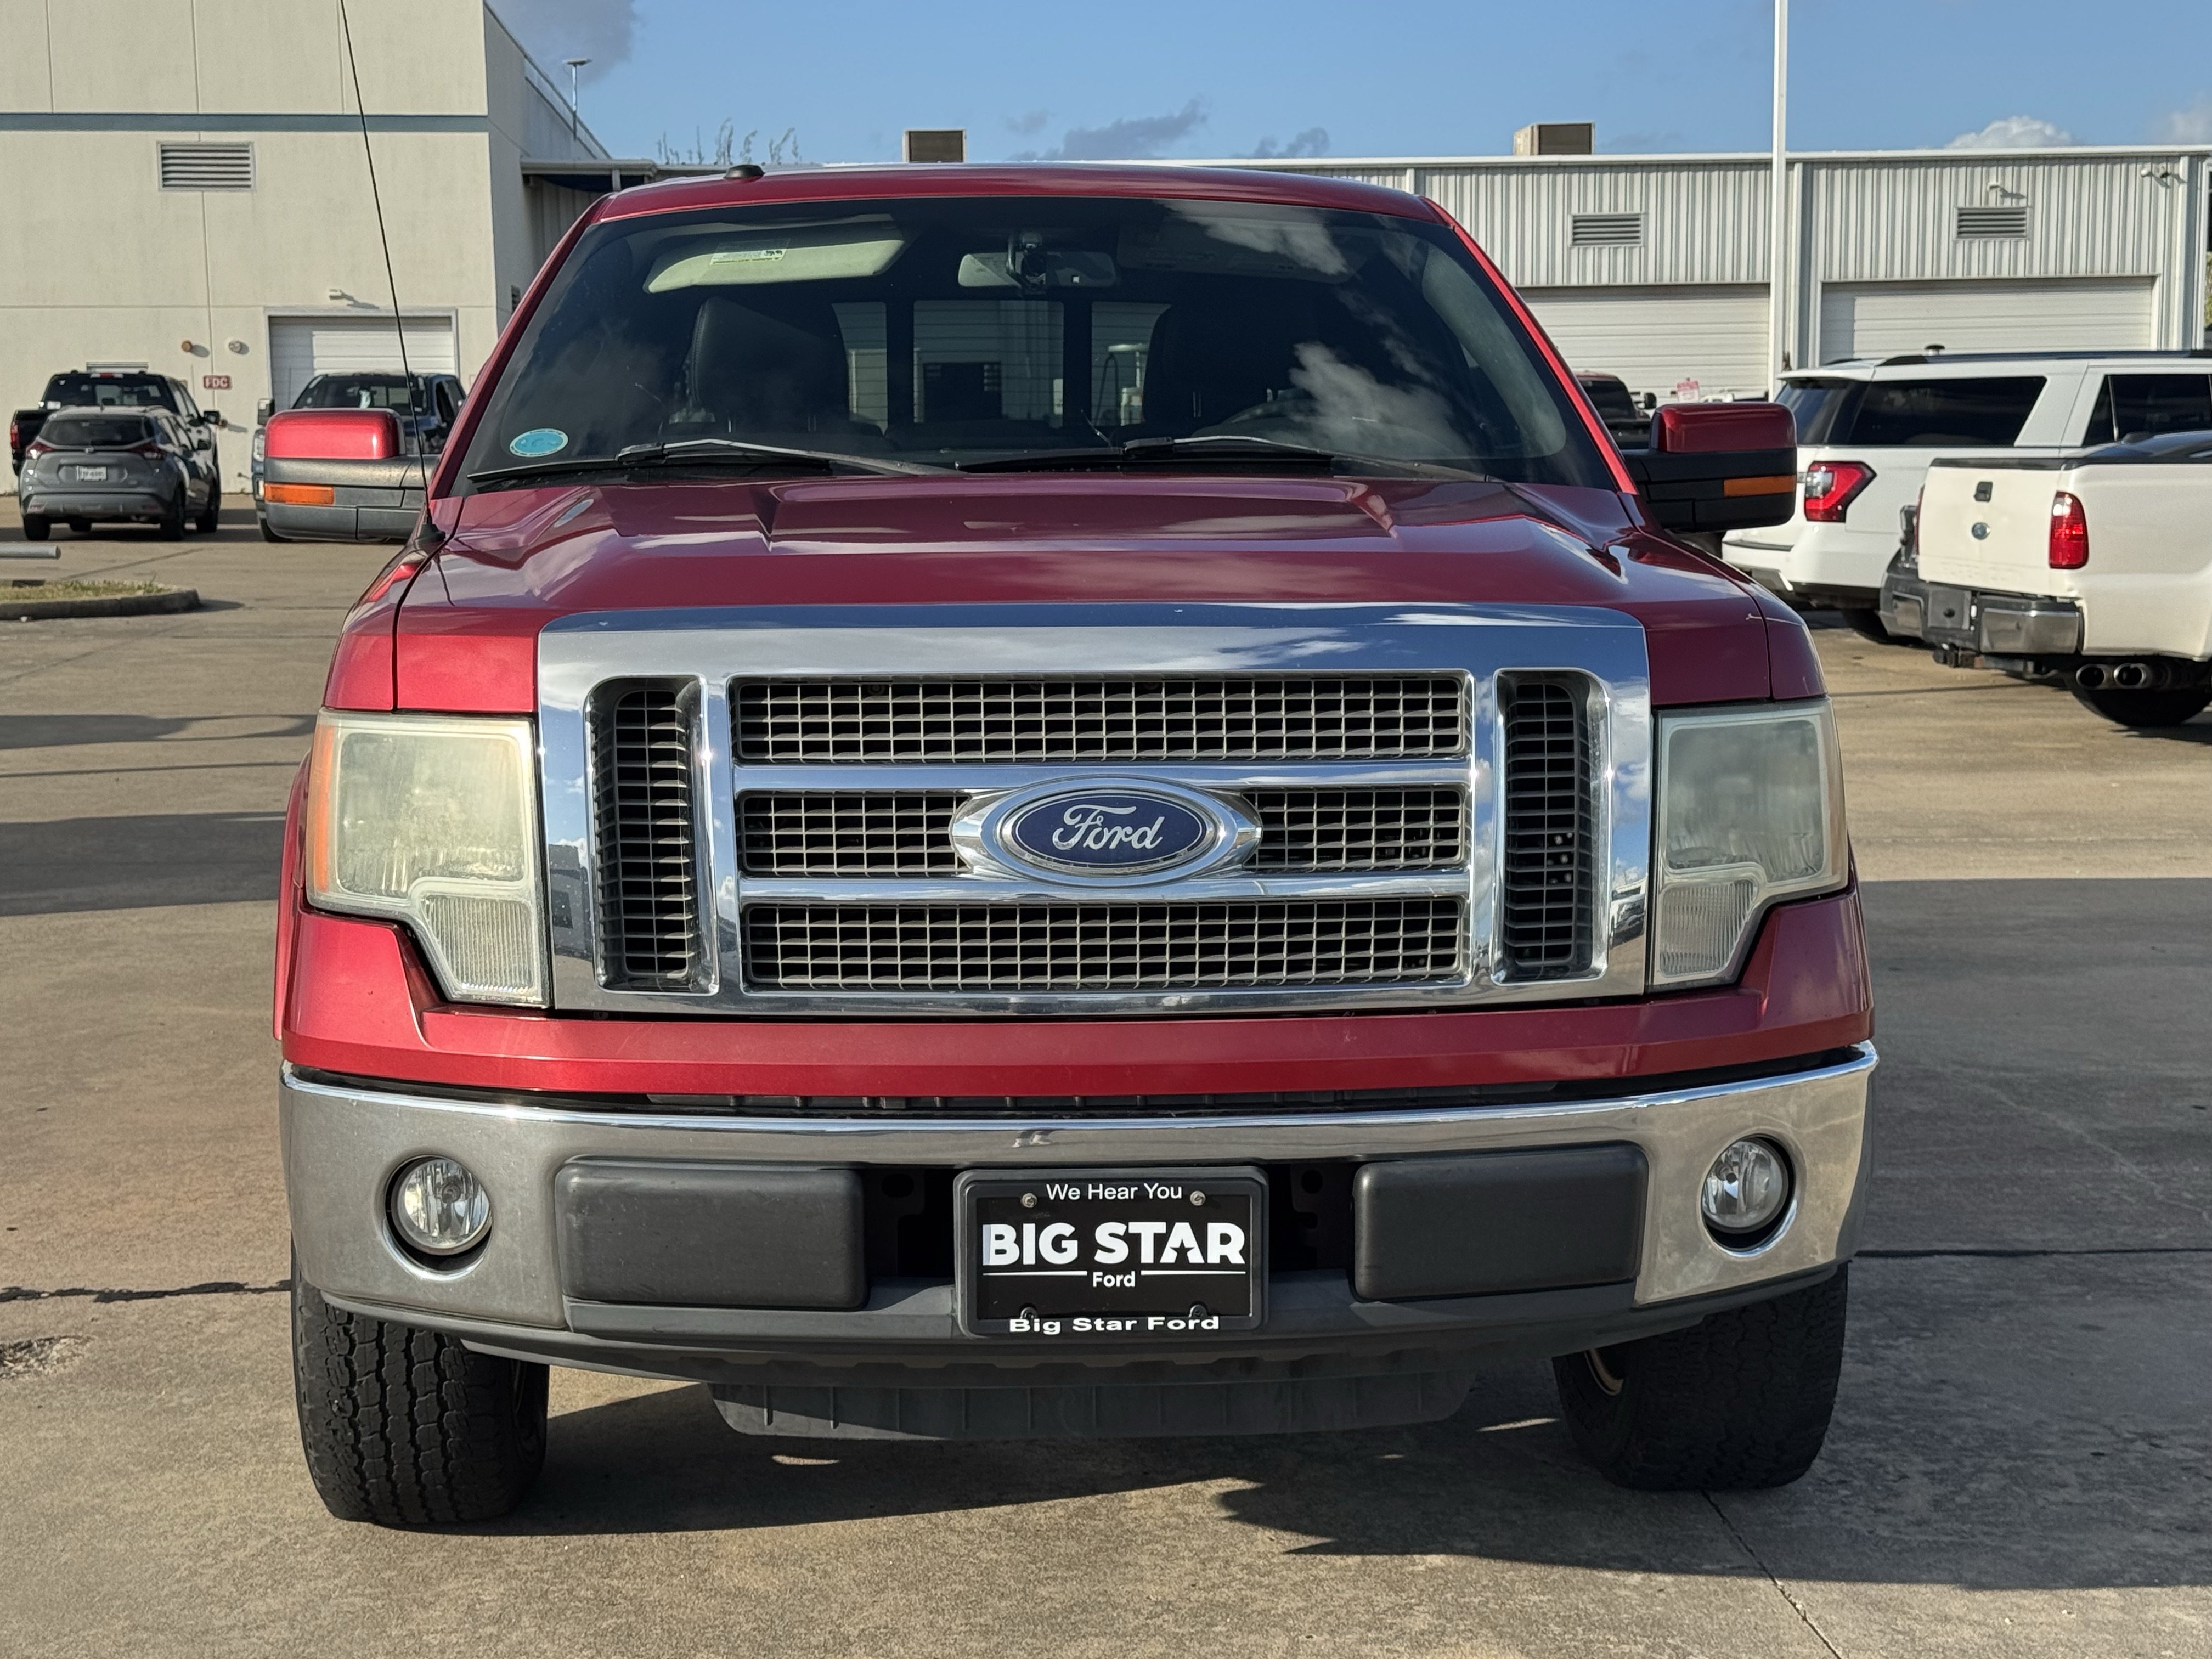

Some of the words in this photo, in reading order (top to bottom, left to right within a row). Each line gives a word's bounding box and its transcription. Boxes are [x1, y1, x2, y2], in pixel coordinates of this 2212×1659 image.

[205, 377, 228, 388] FDC
[1052, 804, 1165, 851] Ford
[1046, 1183, 1080, 1200] We
[1087, 1183, 1138, 1200] Hear
[1143, 1182, 1182, 1199] You
[982, 1222, 1079, 1266] BIG
[1094, 1221, 1245, 1265] STAR
[1092, 1271, 1136, 1288] Ford
[1009, 1317, 1062, 1335] Big
[1072, 1317, 1137, 1331] Star
[1147, 1316, 1220, 1330] Ford
